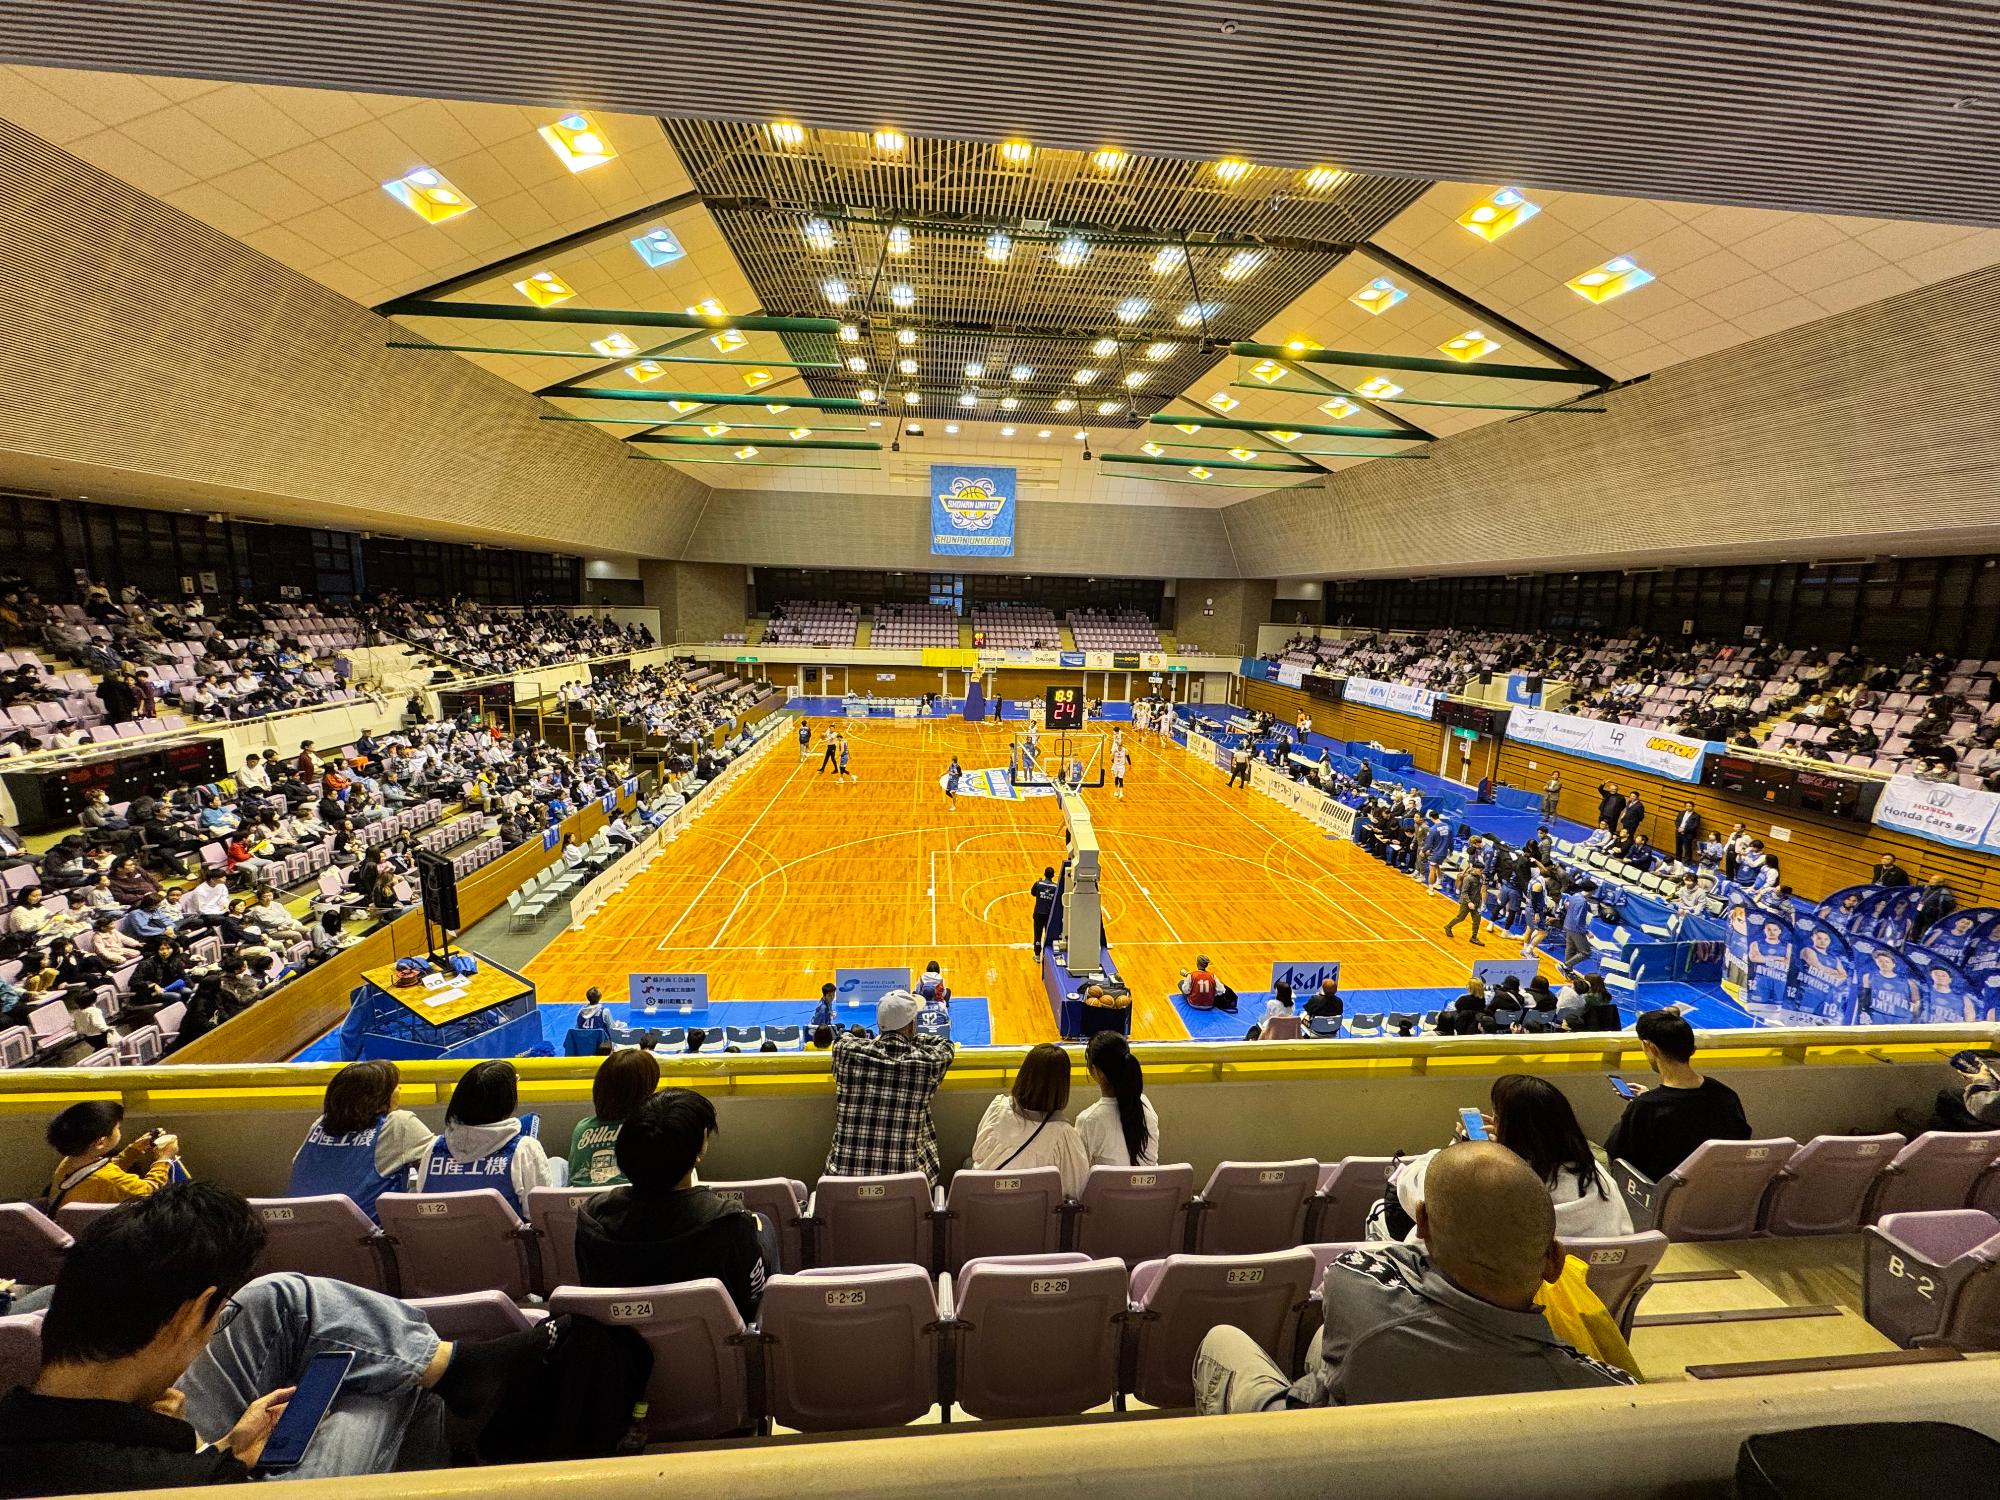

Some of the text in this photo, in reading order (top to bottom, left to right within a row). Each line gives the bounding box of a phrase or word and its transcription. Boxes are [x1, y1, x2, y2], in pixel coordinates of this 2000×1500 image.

[948, 500, 999, 510] SHONAN UNITED
[1055, 689, 1074, 702] 18.9
[1054, 702, 1076, 719] 24
[1884, 805, 1922, 821] Honda
[1925, 815, 1952, 829] Cars
[1913, 803, 1953, 817] HONDA
[1197, 979, 1210, 993] 11
[582, 1018, 594, 1029] 41
[921, 1012, 938, 1026] 92
[429, 1156, 508, 1175] 日産工機
[1627, 1178, 1651, 1208] B-1
[1228, 1270, 1262, 1282] B-2-27
[1888, 1254, 1935, 1299] B-2
[1033, 1281, 1067, 1292] B-2-26
[827, 1292, 864, 1304] B-2-25
[612, 1303, 651, 1316] B-2-24
